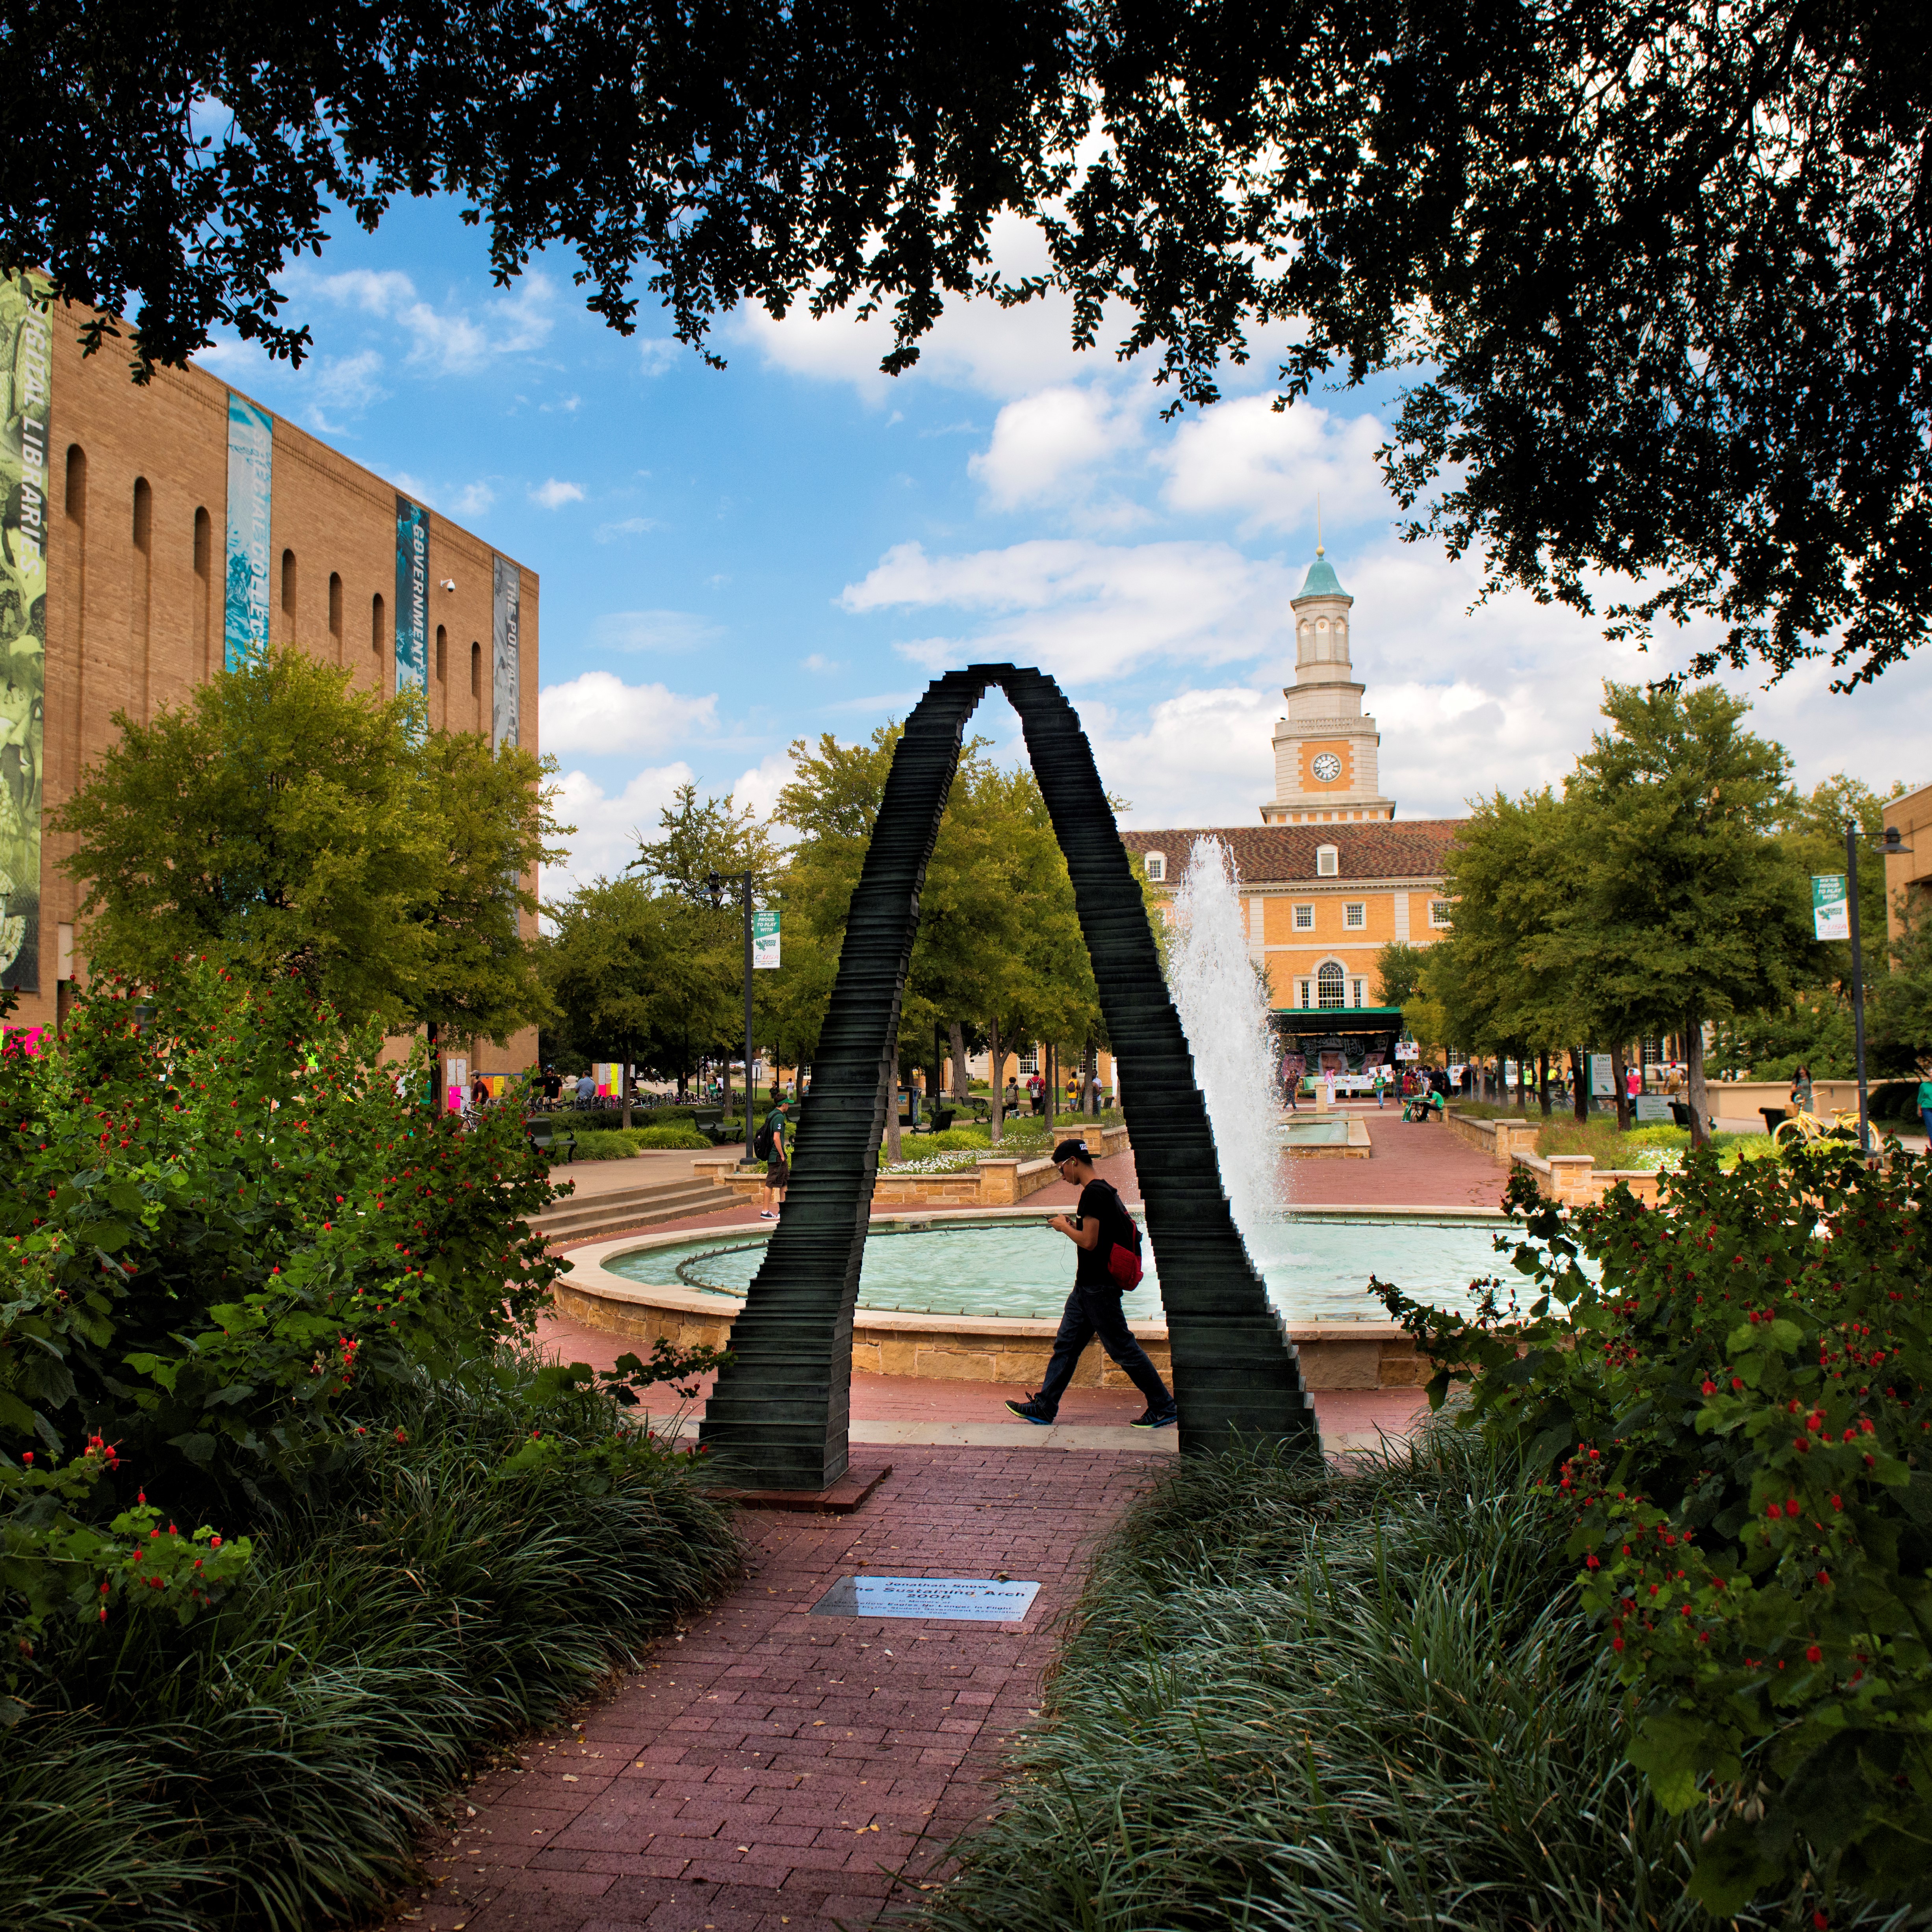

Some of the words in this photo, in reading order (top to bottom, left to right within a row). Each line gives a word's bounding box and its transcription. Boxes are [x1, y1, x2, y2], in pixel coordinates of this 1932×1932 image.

[20, 416, 43, 577] LIBRARIES
[252, 430, 266, 531] SPECIAL
[413, 524, 424, 669] GOVERNMENT
[507, 580, 516, 615] THE
[508, 619, 517, 690] PORTAL
[509, 696, 516, 718] TO
